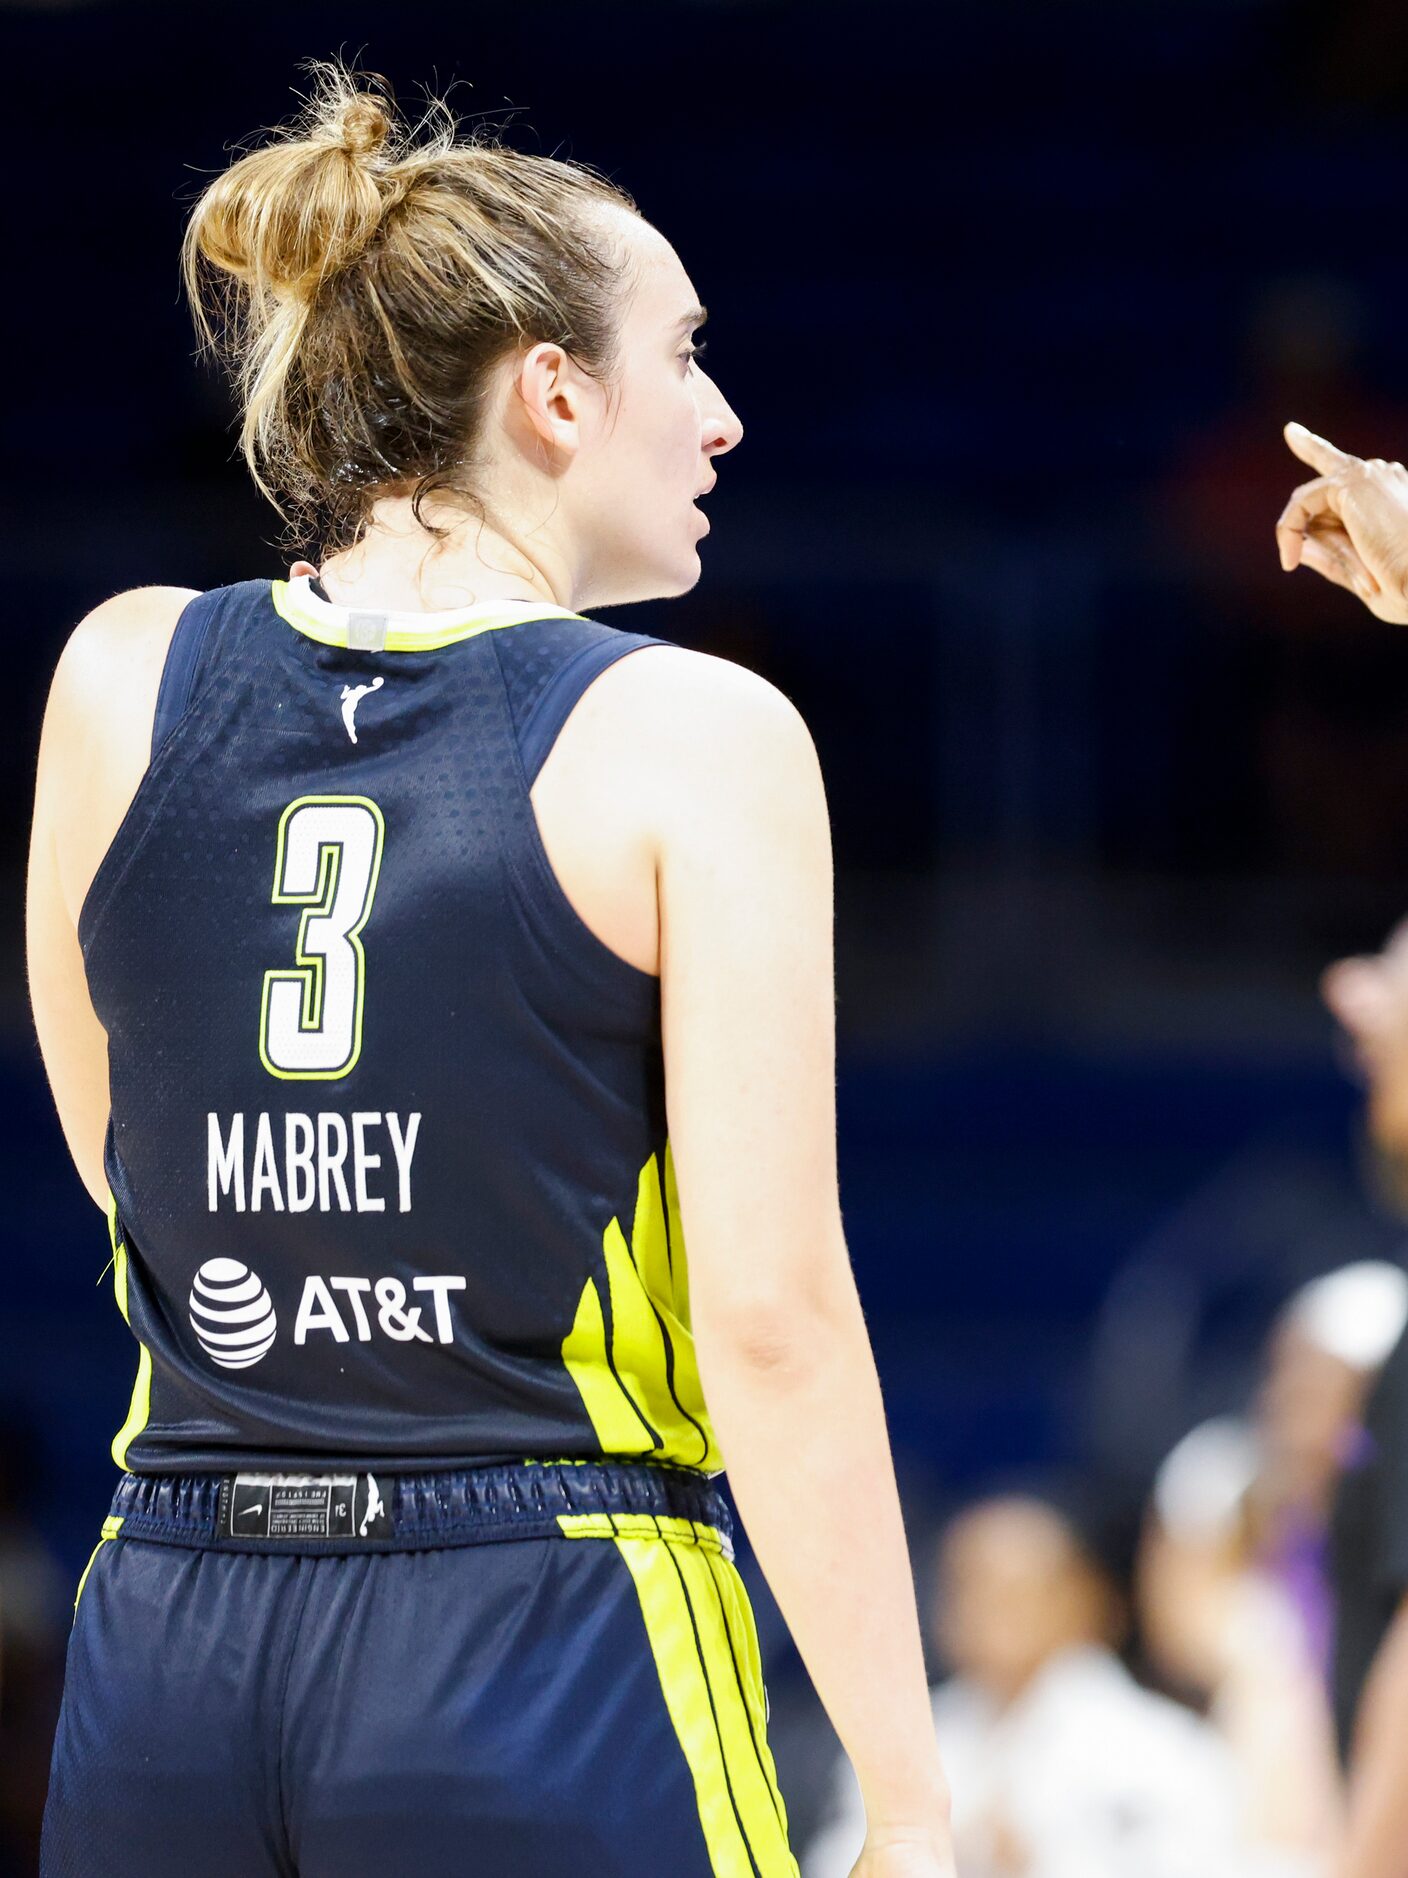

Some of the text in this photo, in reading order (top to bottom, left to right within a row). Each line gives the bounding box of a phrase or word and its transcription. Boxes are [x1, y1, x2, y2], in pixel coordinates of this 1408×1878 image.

[259, 795, 385, 1081] 3
[208, 1112, 422, 1213] MABREY
[295, 1276, 467, 1344] AT&T
